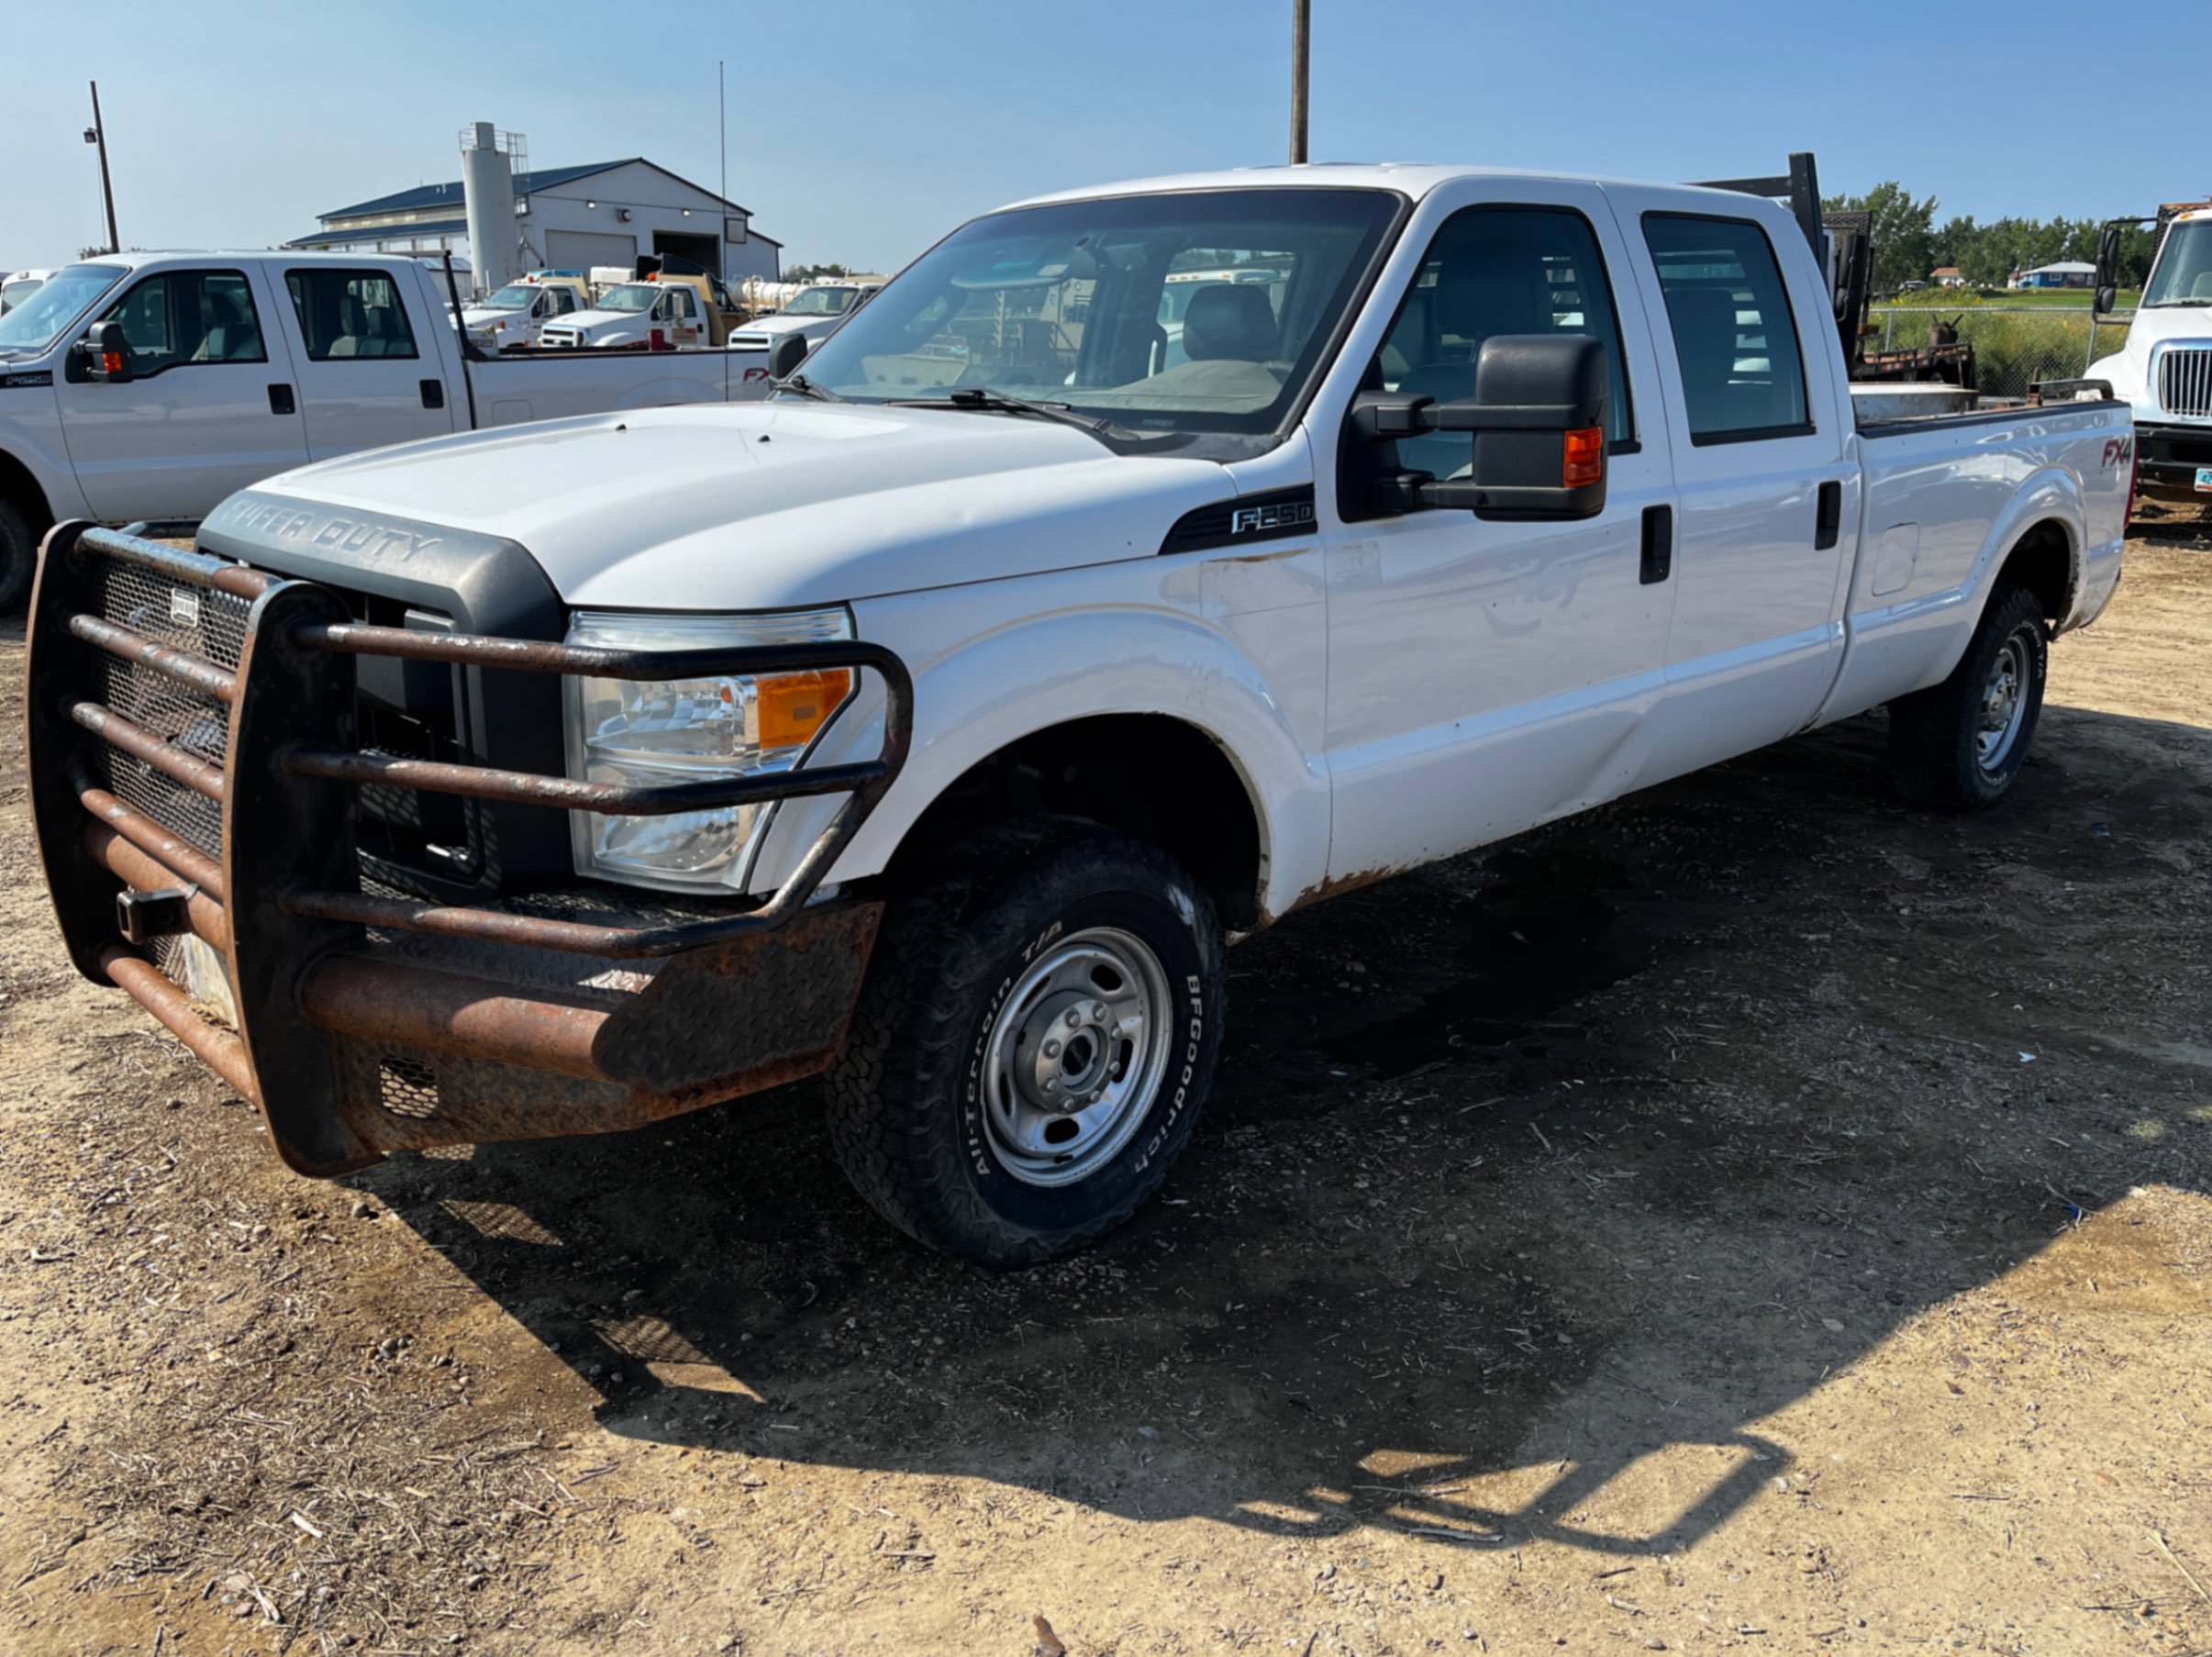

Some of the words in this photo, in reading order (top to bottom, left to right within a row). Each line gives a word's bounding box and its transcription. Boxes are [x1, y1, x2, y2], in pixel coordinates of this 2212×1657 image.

[2101, 438, 2132, 468] FX4
[221, 499, 317, 539] SUPER
[312, 517, 444, 562] DUTY
[965, 976, 1011, 1175] All-Terrain
[1021, 920, 1062, 962] T/A
[1134, 975, 1203, 1173] BFGoodrich
